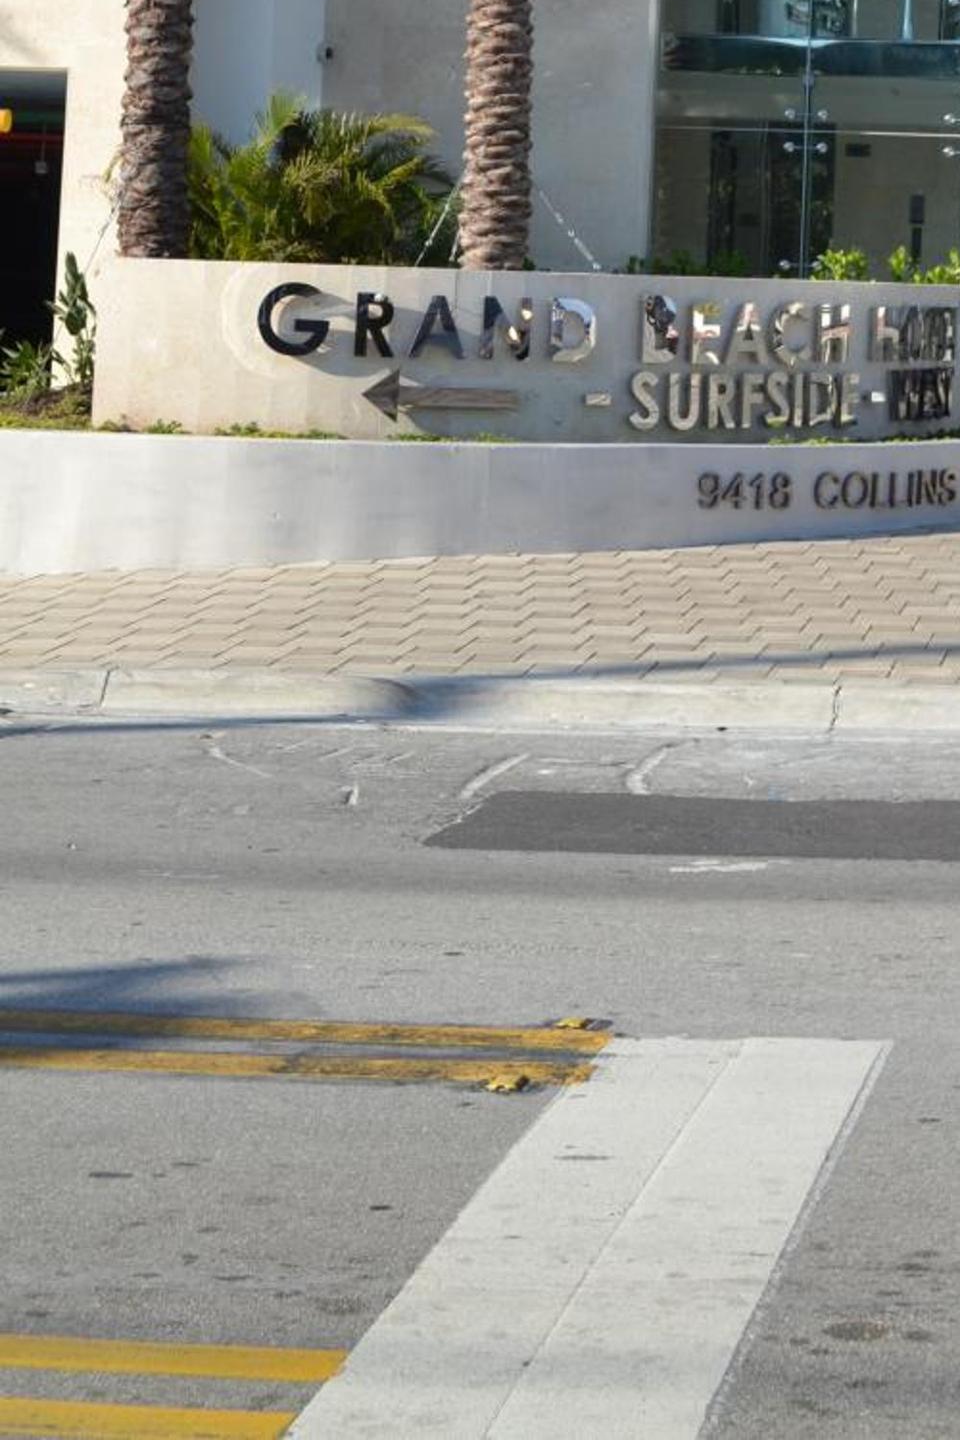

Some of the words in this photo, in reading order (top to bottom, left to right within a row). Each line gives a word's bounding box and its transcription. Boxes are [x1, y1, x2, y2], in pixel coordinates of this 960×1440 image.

[257, 281, 599, 363] GRAND
[641, 294, 852, 365] BEACH
[629, 368, 861, 432] SURFSIDE
[697, 470, 793, 511] 9418
[813, 467, 957, 510] COLLINS
